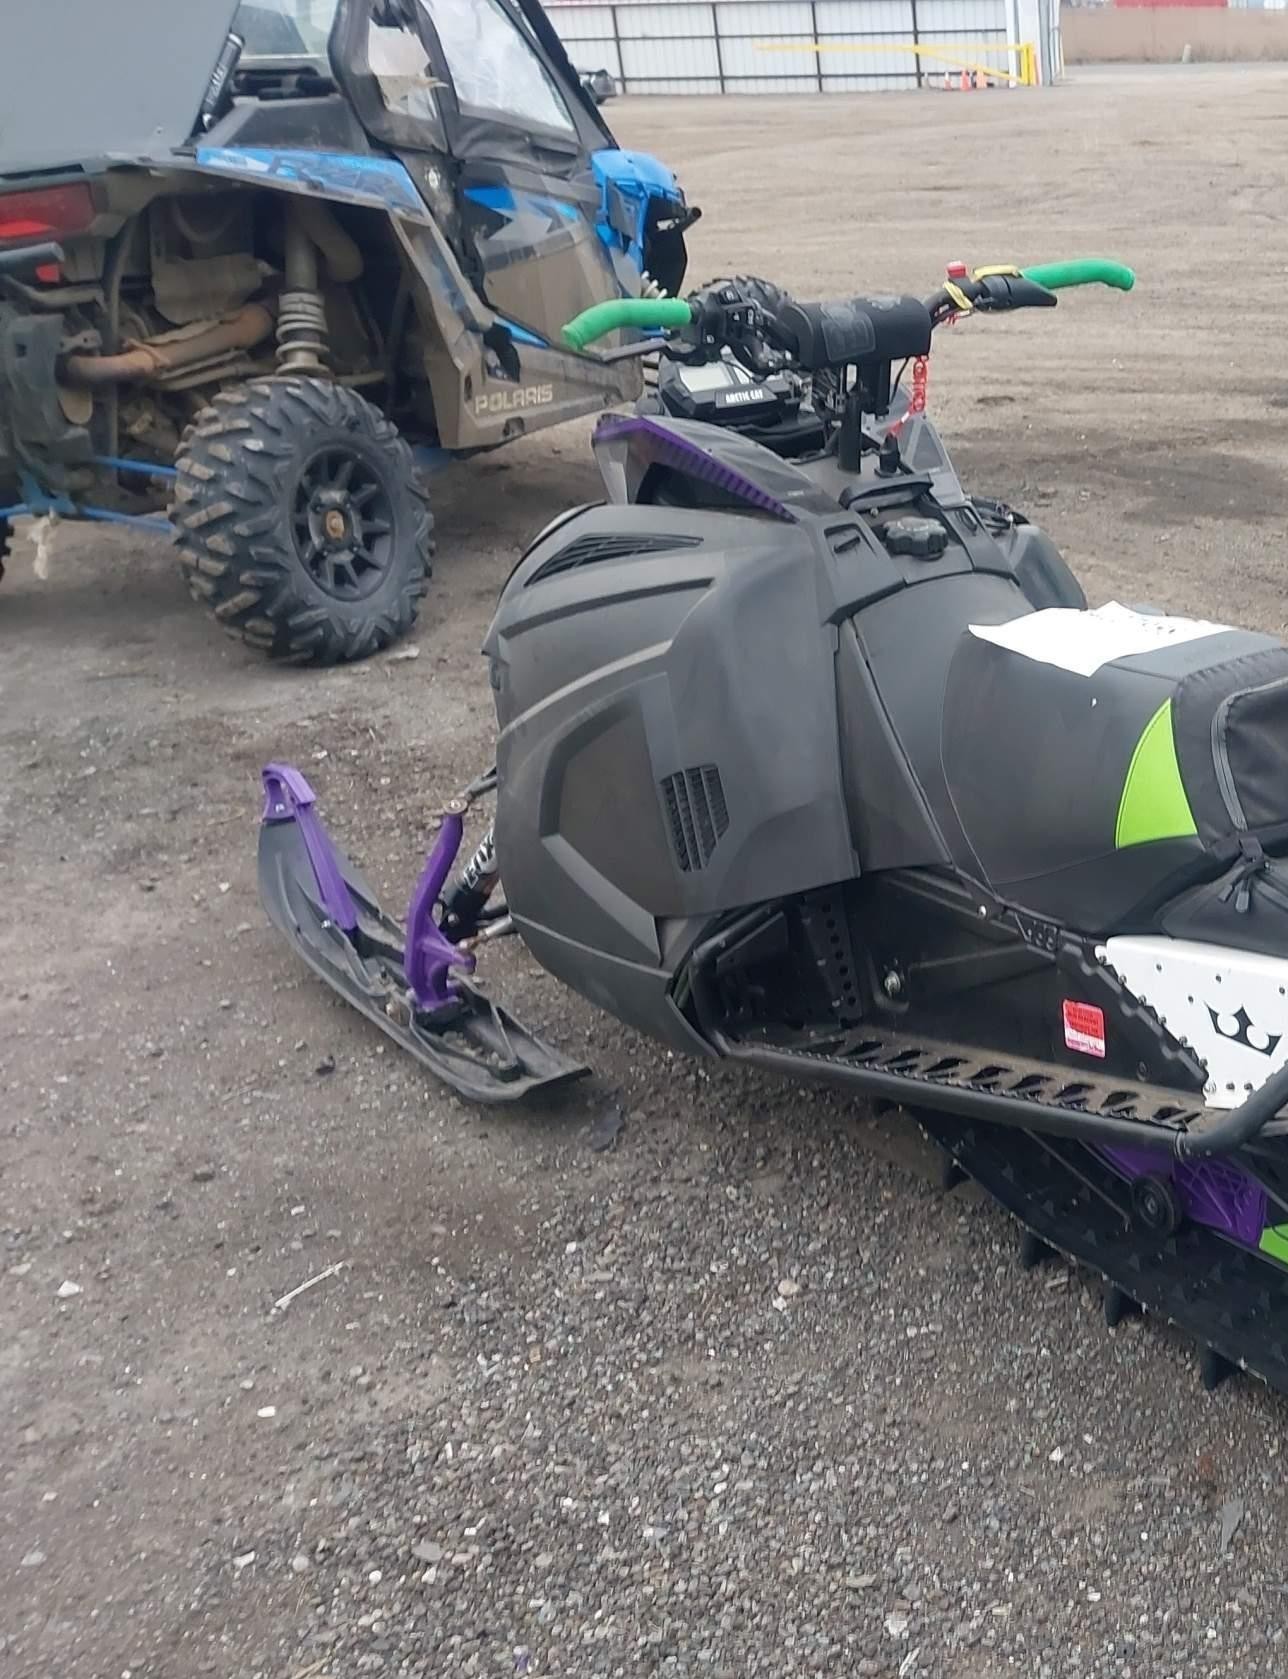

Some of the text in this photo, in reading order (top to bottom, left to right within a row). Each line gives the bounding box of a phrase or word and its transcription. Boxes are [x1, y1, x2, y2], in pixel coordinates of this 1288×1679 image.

[475, 384, 553, 414] POLARIS
[725, 389, 763, 404] ARCTIC CAT
